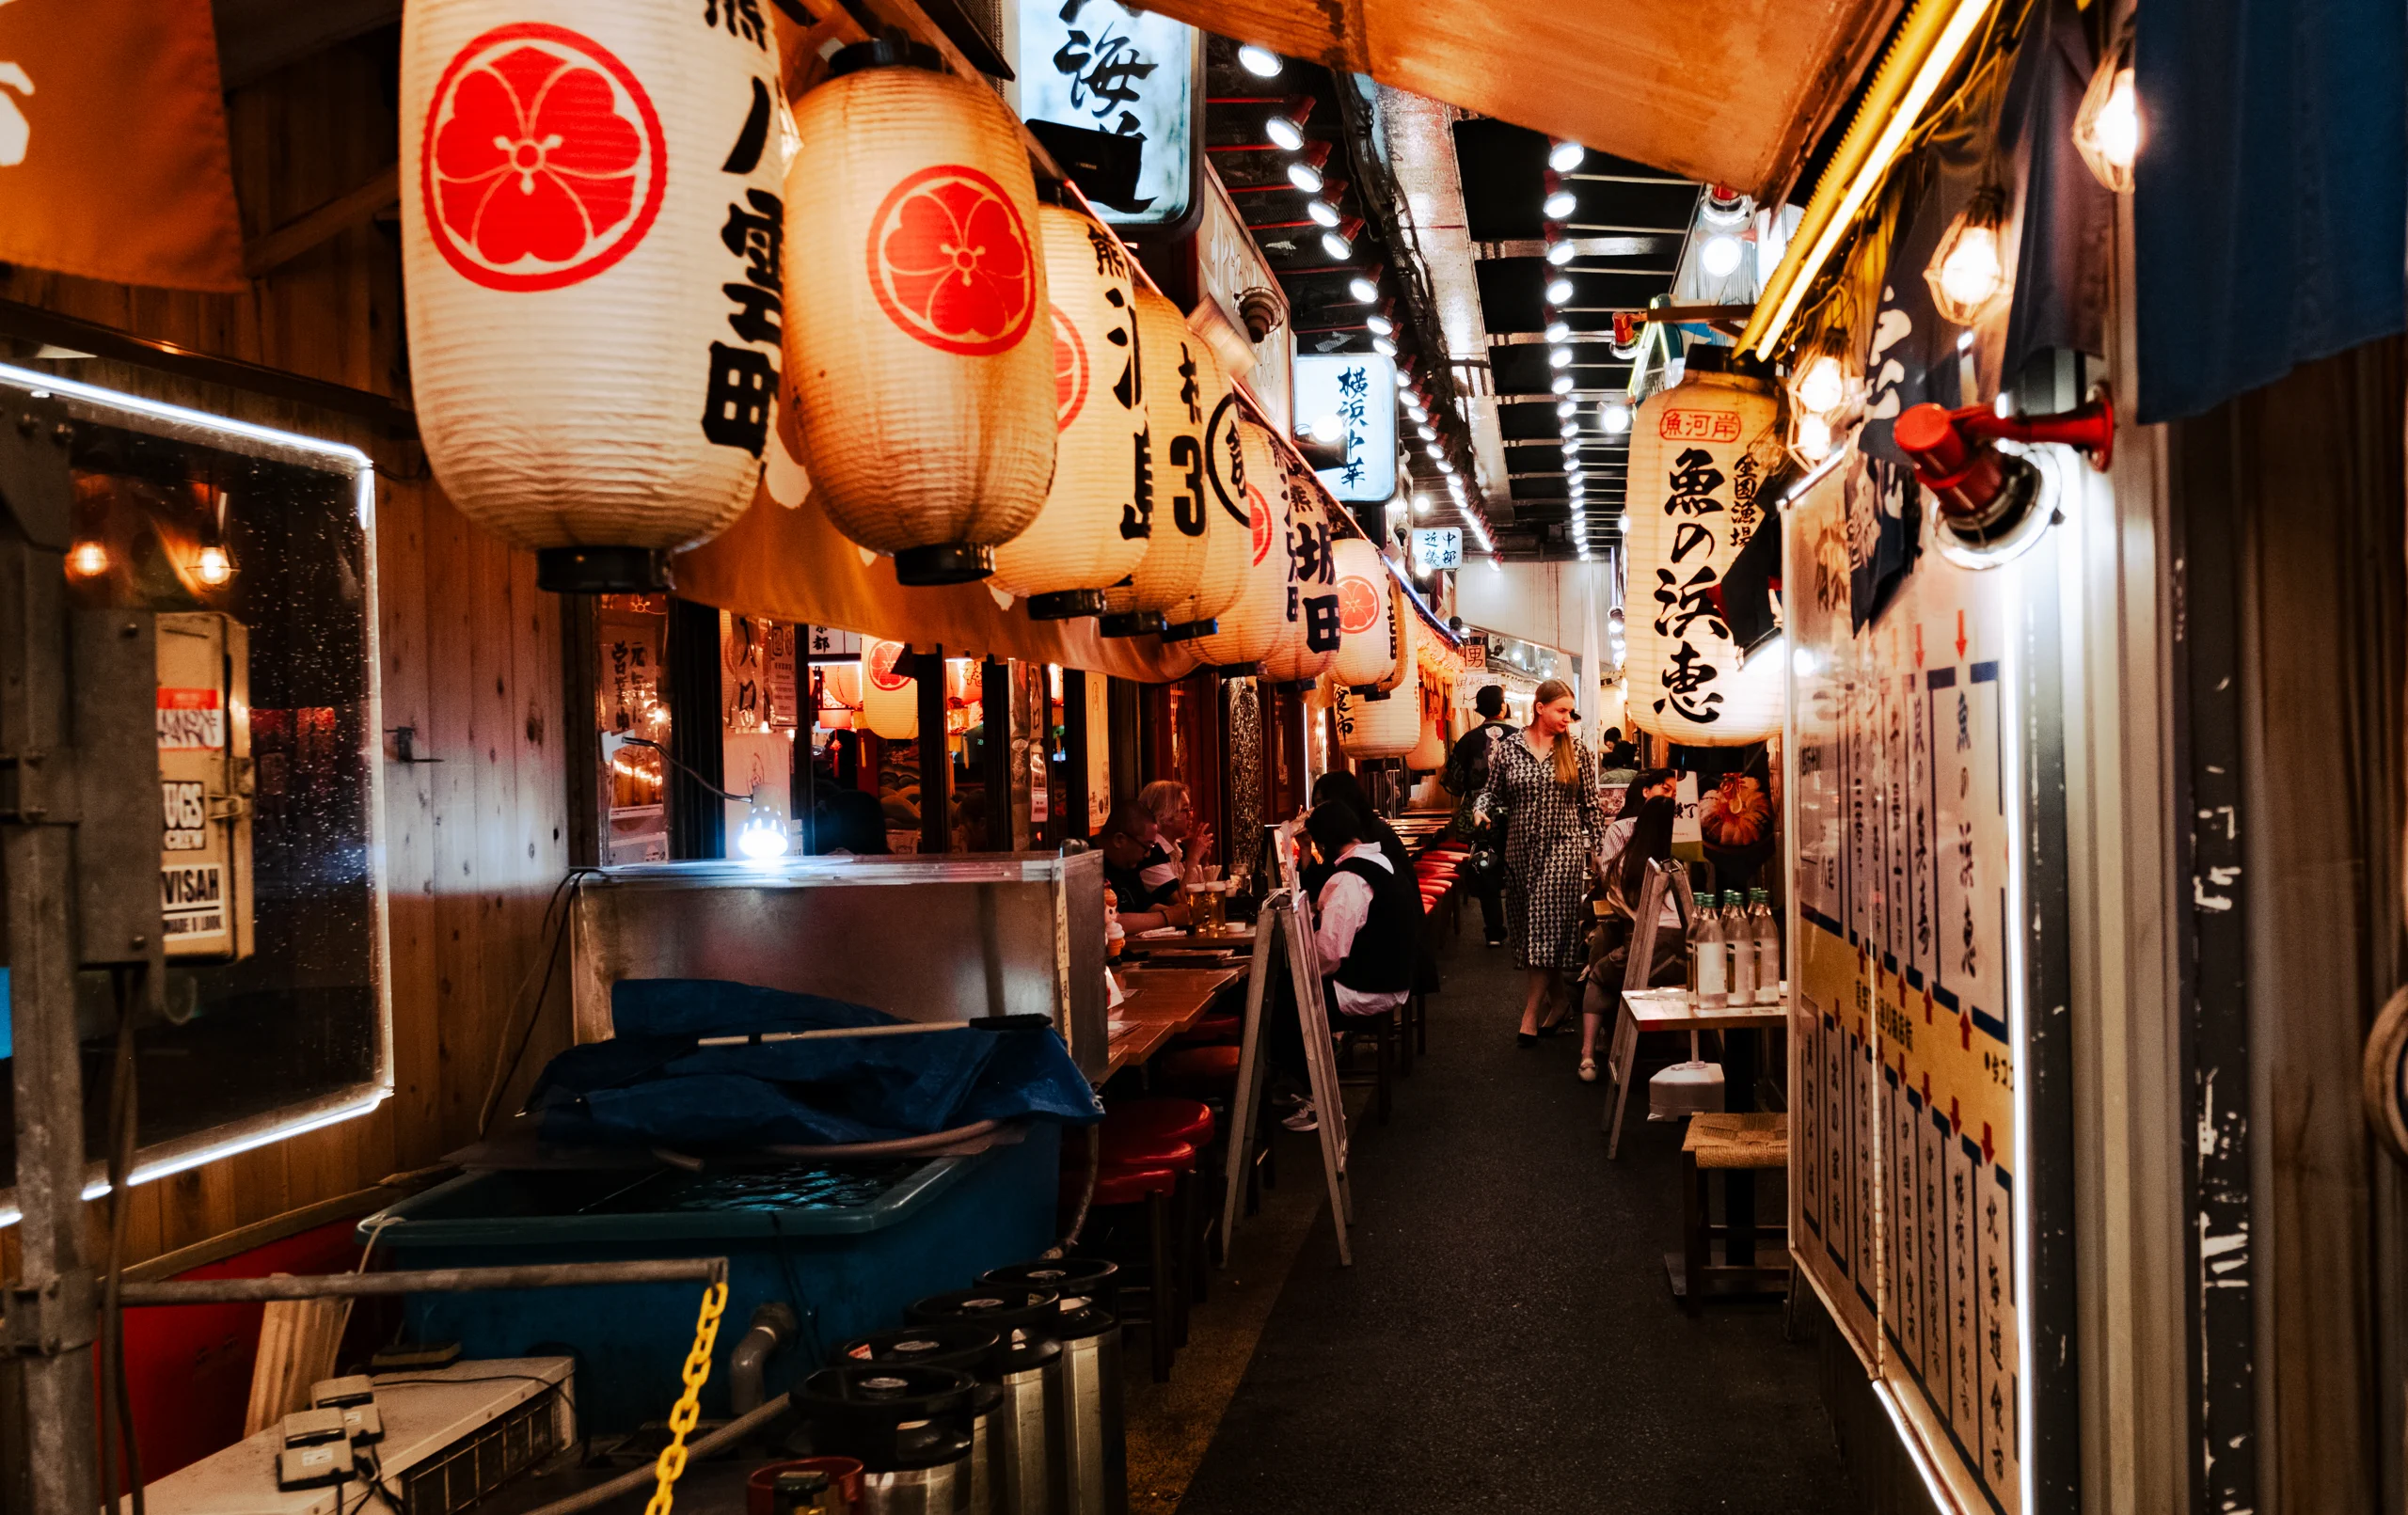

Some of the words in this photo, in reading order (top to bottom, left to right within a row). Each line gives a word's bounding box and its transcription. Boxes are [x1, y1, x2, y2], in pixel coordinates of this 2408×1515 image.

[1336, 366, 1370, 491] 横浜中華
[1664, 412, 1737, 439] 魚河岸
[1441, 530, 1457, 566] 中部
[1653, 447, 1730, 724] 魚の浜恵
[1467, 647, 1483, 668] 男
